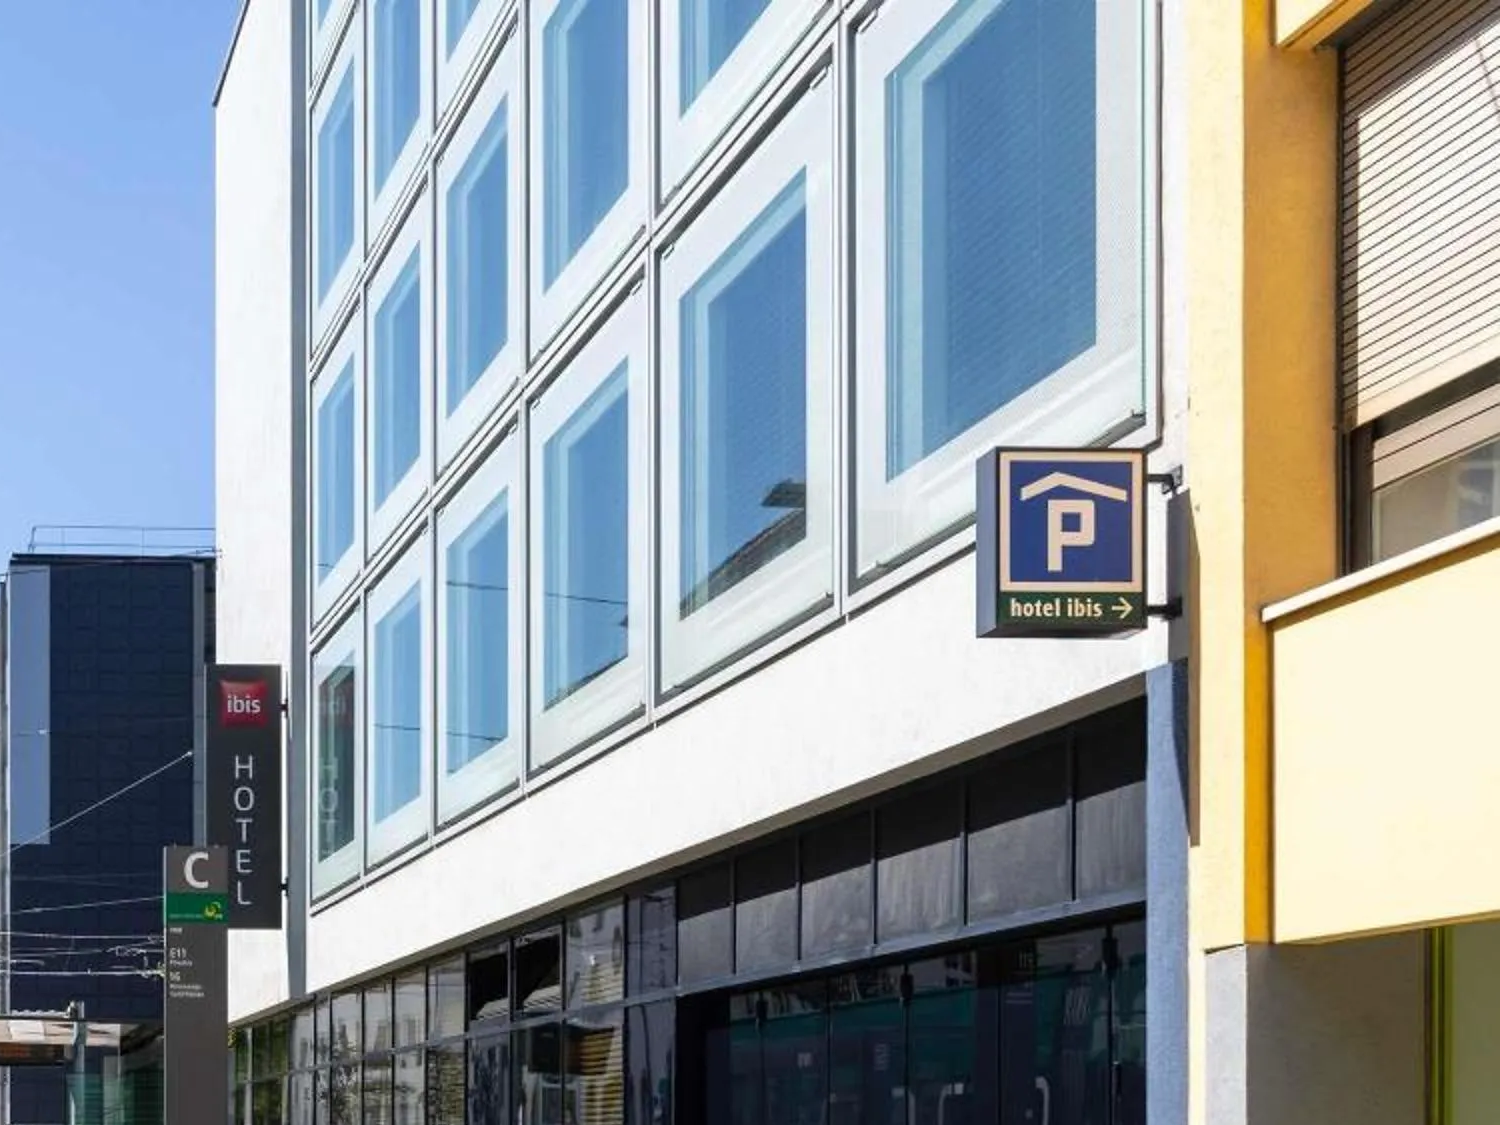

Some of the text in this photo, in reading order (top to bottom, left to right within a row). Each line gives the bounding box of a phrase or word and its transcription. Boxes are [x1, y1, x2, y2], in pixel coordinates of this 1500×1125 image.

[1048, 499, 1095, 571] P
[1010, 598, 1102, 616] hotel ibis
[227, 695, 261, 713] ibis
[233, 755, 255, 905] HOTEL
[183, 852, 209, 889] C
